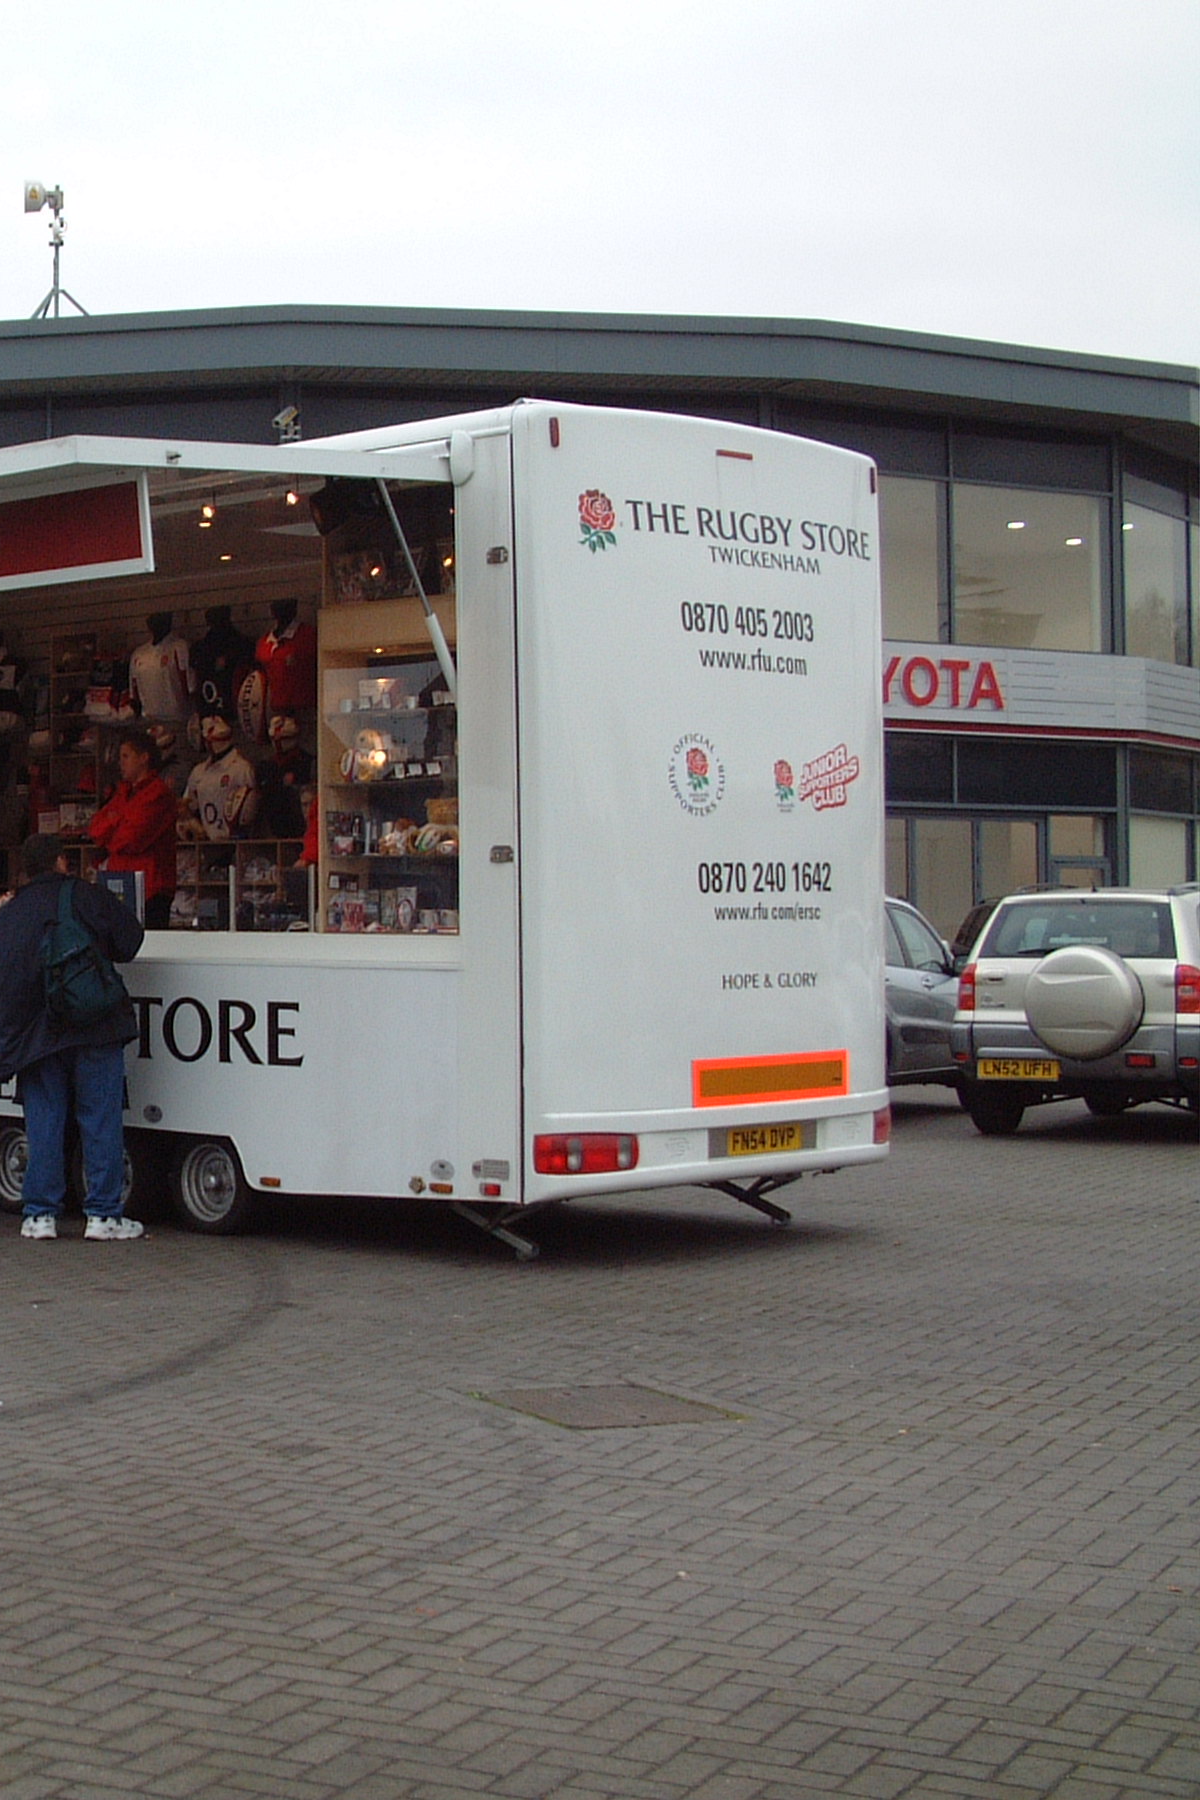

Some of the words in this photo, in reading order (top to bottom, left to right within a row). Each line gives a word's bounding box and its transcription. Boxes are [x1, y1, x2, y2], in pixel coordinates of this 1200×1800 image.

[625, 500, 689, 535] THE
[696, 507, 792, 547] RUGBY
[801, 520, 871, 560] STORE
[708, 546, 821, 575] TWICKENHAM
[681, 601, 729, 634] 0870
[735, 606, 768, 637] 405
[773, 610, 814, 642] 2003
[699, 648, 808, 675] www.rfu.com
[883, 656, 1004, 709] YOTA
[673, 733, 714, 754] OFFICIAL
[812, 784, 847, 811] CLUB
[699, 862, 747, 893] 0870
[752, 862, 786, 892] 240
[792, 862, 832, 892] 1642
[714, 902, 821, 921] www.rfucom/ersc
[722, 973, 760, 990] HOPE
[764, 973, 773, 988] &
[778, 972, 818, 988] GLORY
[127, 997, 304, 1067] TORE
[983, 1061, 1020, 1076] LN52
[732, 1130, 766, 1151] FN54
[770, 1127, 795, 1148] DVP
